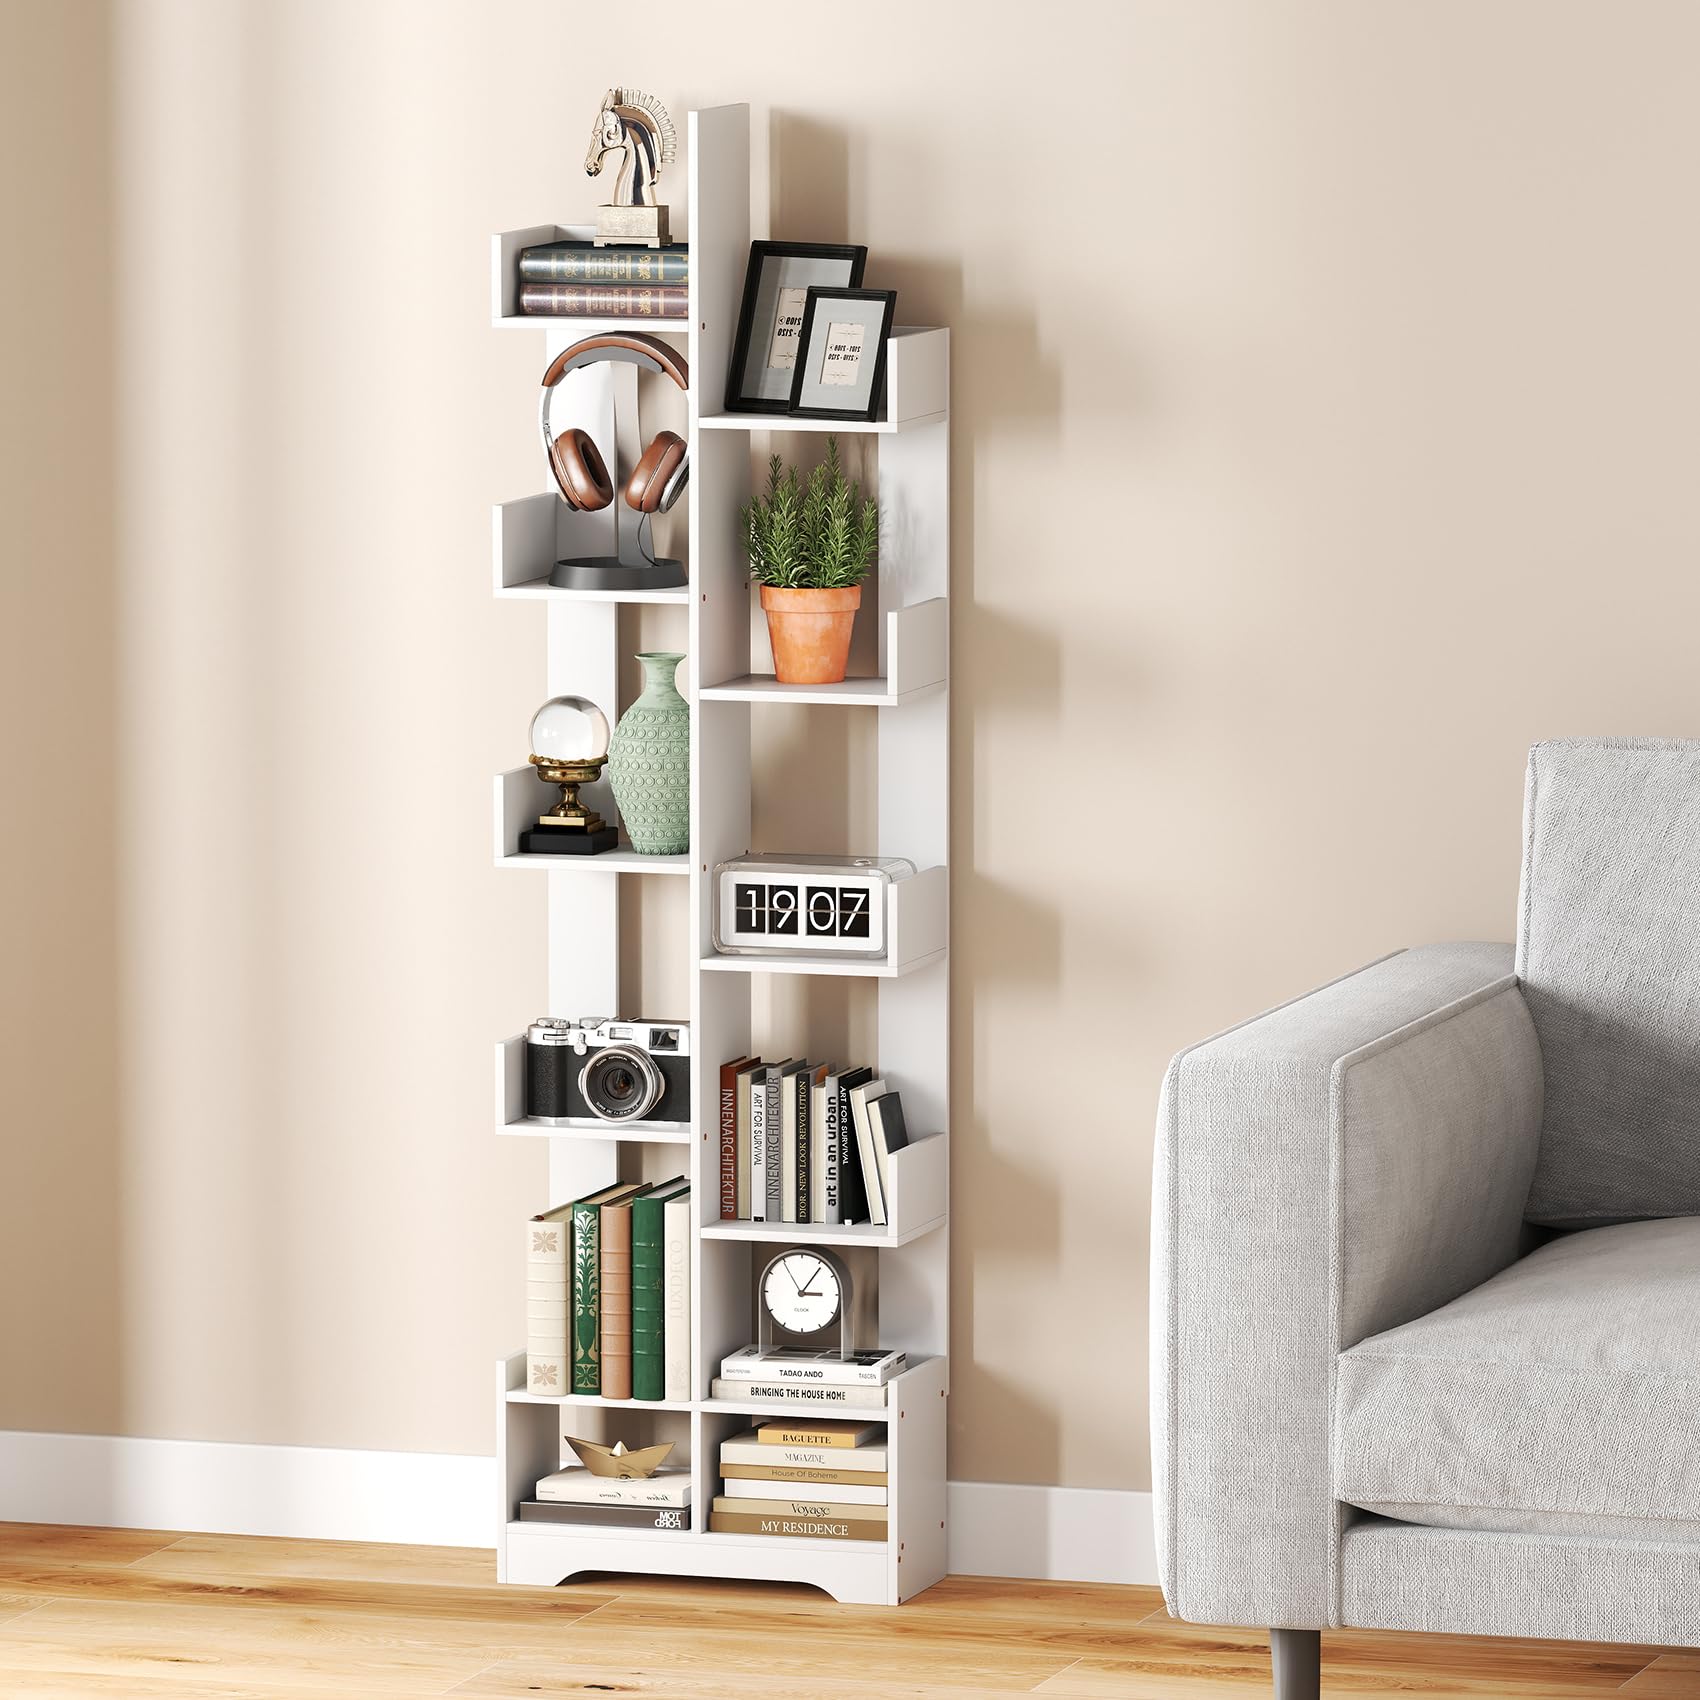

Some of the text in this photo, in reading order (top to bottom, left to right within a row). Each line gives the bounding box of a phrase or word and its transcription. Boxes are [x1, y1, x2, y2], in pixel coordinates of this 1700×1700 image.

[754, 1093, 762, 1165] ART FOR SURVIVAL
[768, 1077, 779, 1200] INNENARCHITEKTUR
[722, 1089, 734, 1213] INNENARCHITEKTUR
[826, 1096, 836, 1206] art in an urban
[751, 1387, 846, 1400] BRINGING THE HOUSE HOME
[783, 1434, 831, 1444] BAGUETTE
[785, 1453, 825, 1464] MAGAZINE
[792, 1504, 830, 1517] Voyage
[761, 1521, 848, 1535] MY RESIDENCE
